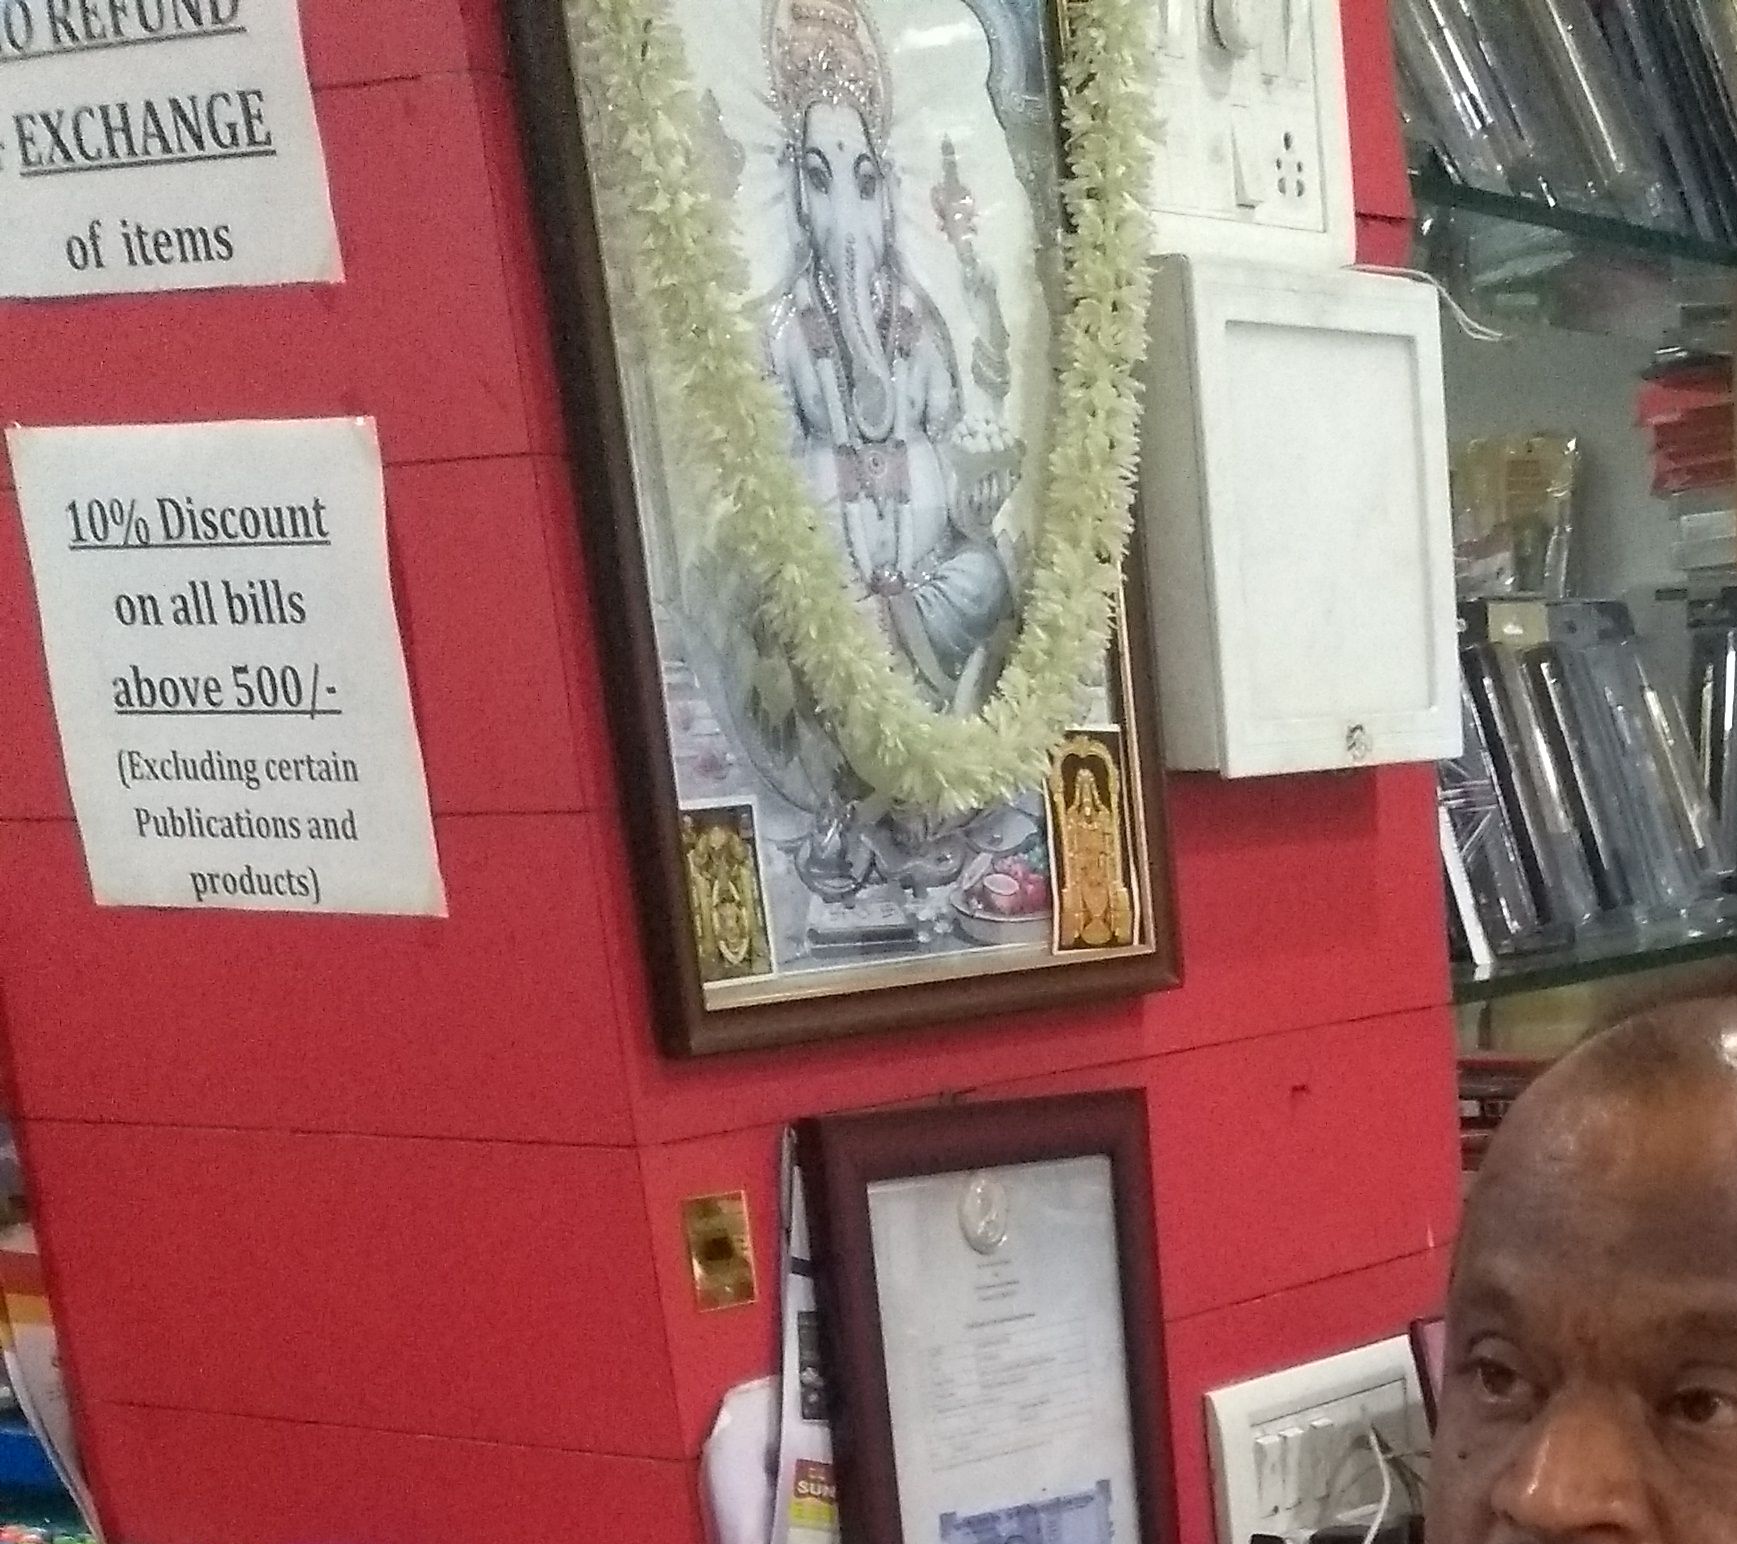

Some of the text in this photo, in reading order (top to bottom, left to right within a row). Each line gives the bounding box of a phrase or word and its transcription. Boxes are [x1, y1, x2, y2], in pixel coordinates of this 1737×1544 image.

[0, 0, 32, 52] O
[13, 89, 272, 168] EXCHANGE
[65, 219, 235, 271] of items
[67, 495, 329, 547] 10% Discount
[115, 577, 307, 628] on all bills
[113, 661, 339, 720] above 500/-
[117, 748, 360, 790] (Excluding certain
[135, 808, 358, 842] Publications and
[191, 865, 323, 906] products)
